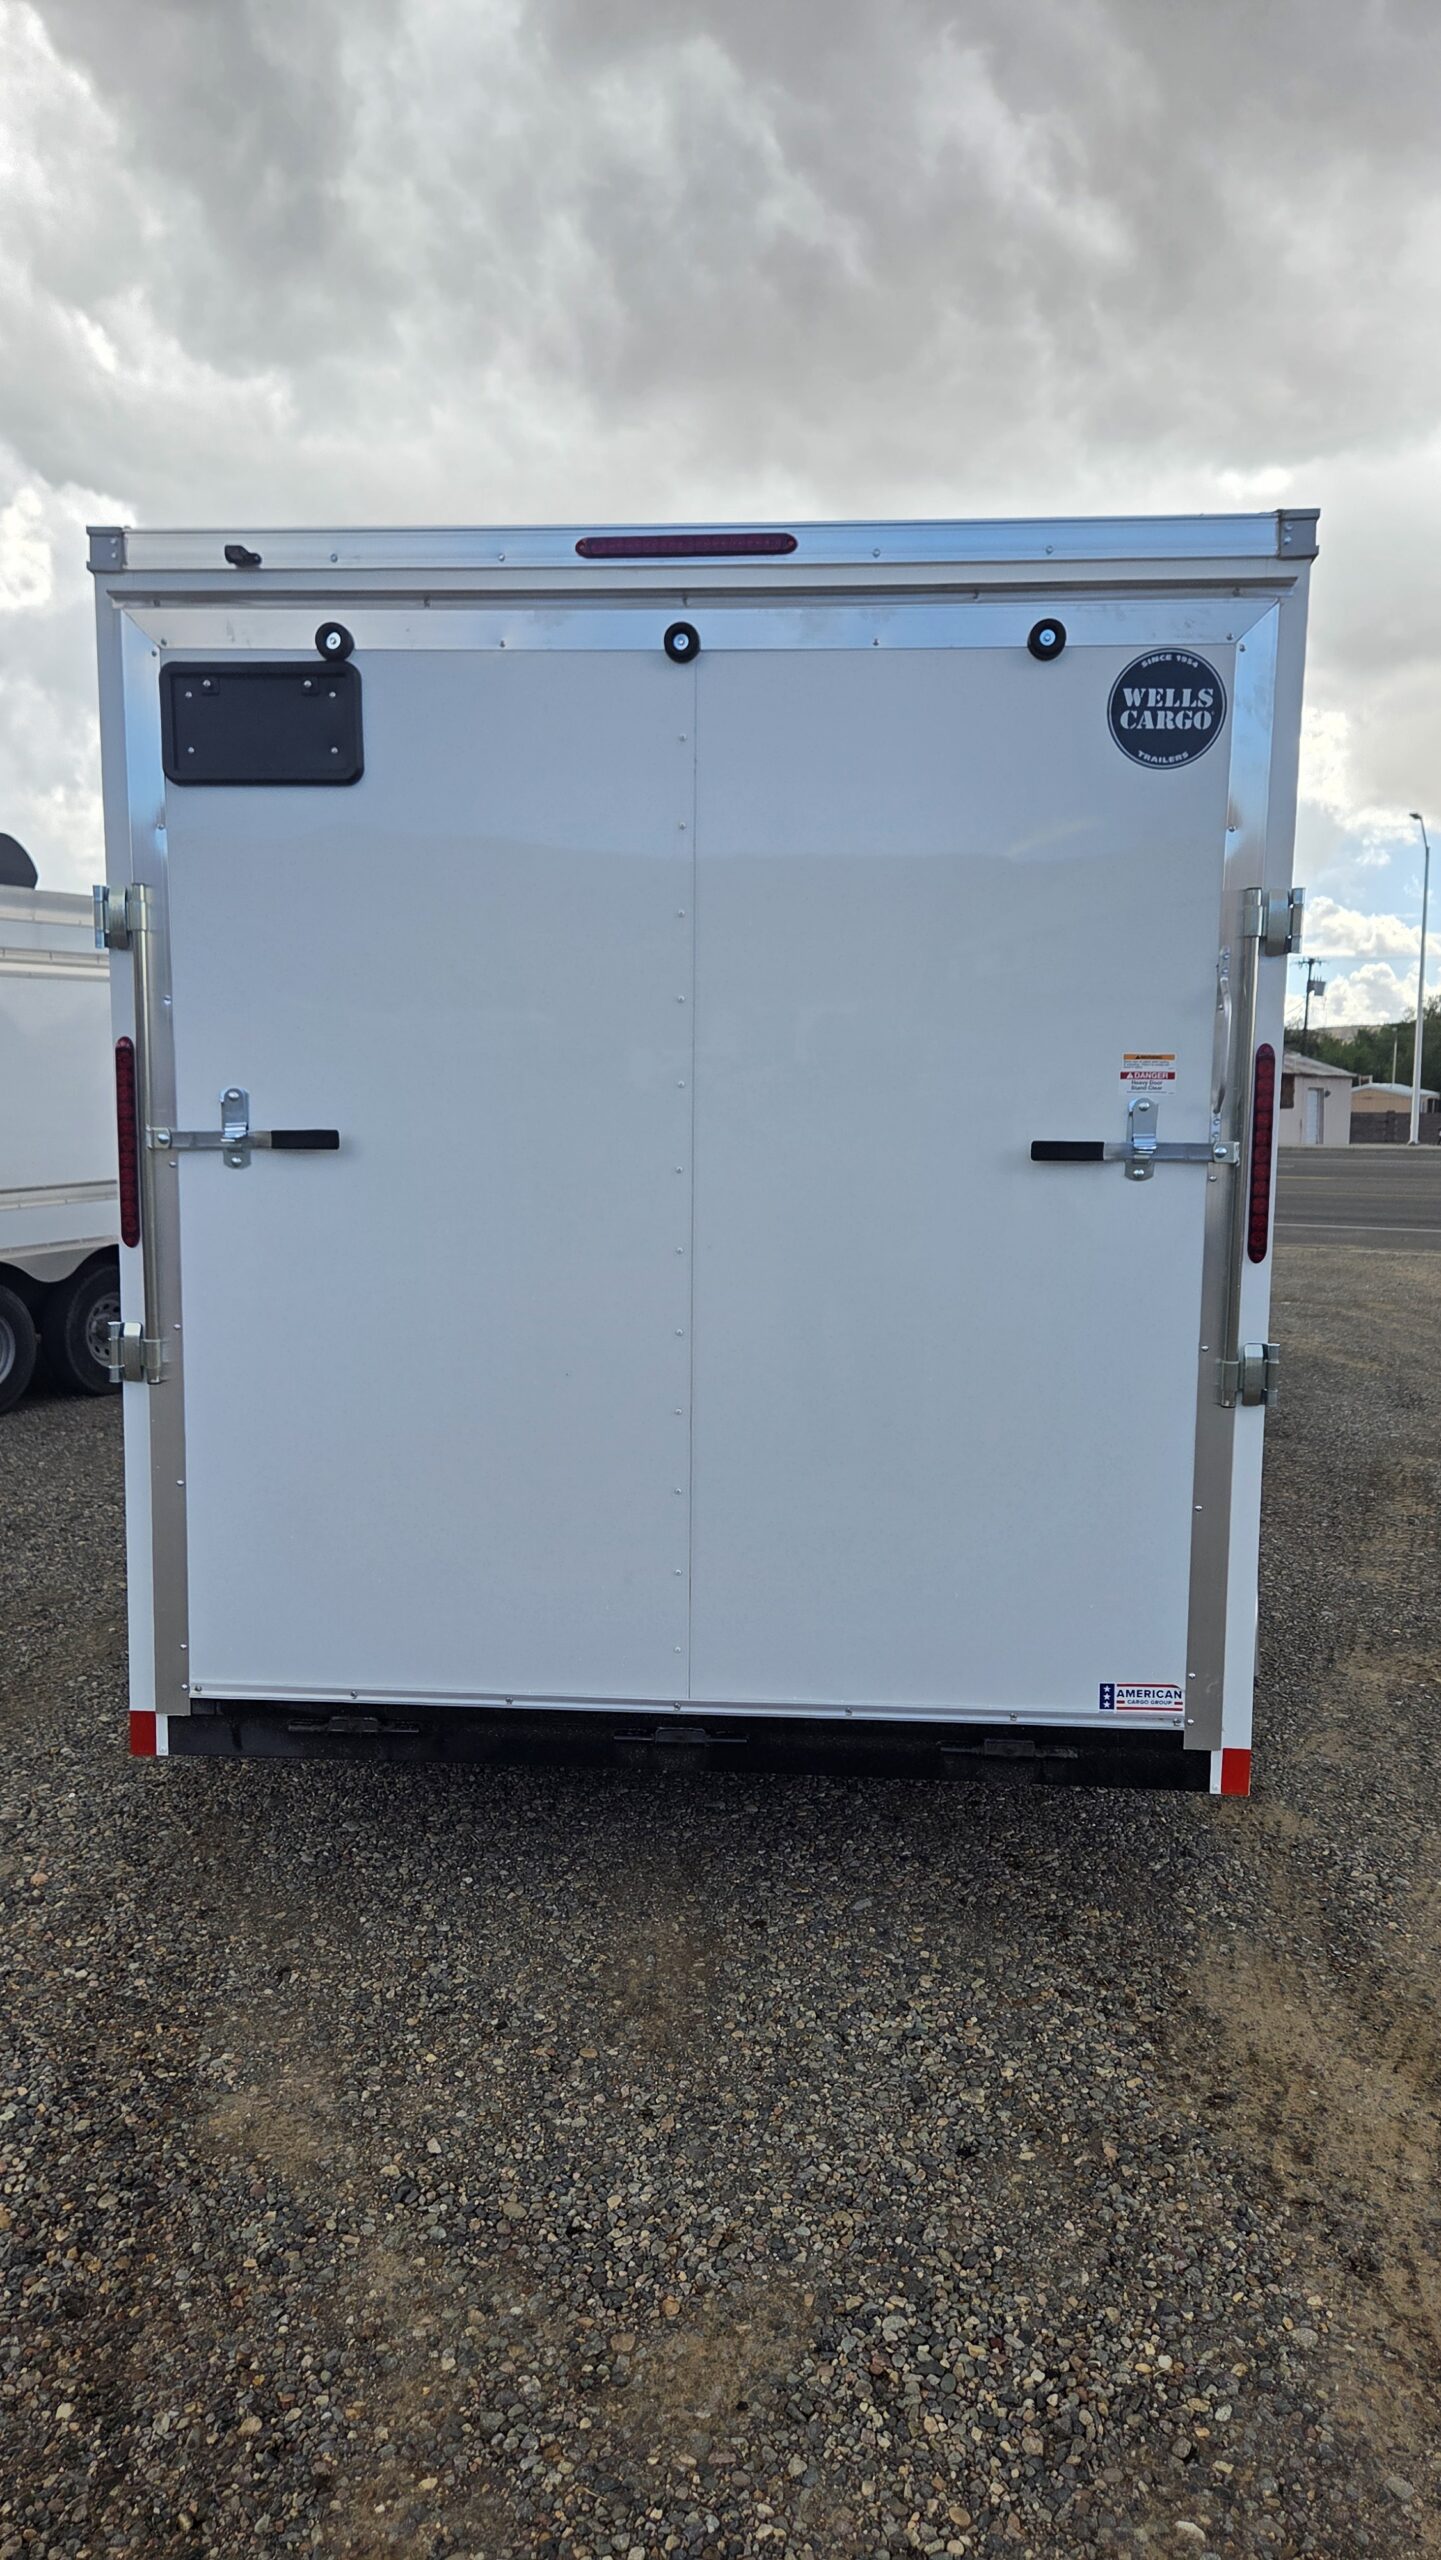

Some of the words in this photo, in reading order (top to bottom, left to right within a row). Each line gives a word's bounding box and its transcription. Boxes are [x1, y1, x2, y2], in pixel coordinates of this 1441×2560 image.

[1141, 654, 1172, 668] SINCE
[1123, 688, 1214, 708] WELLS
[1120, 710, 1212, 730] CARGO
[1137, 750, 1189, 764] TRAILERS
[1116, 1690, 1182, 1699] AMERICAN
